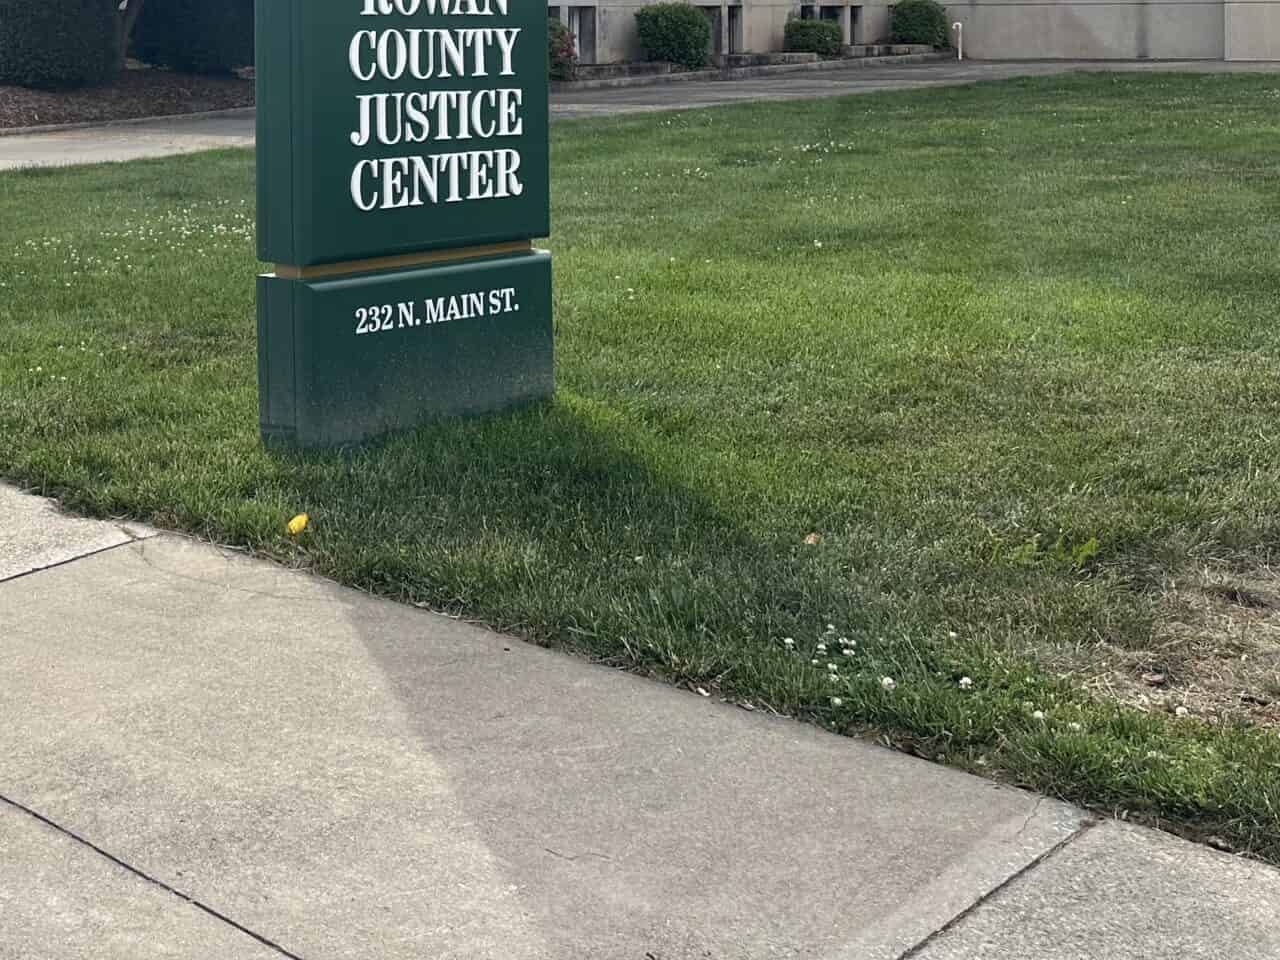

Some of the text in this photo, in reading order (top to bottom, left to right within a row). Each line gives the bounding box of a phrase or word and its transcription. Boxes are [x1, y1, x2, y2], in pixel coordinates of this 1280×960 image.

[348, 28, 522, 80] COUNTY
[350, 89, 523, 146] JUSTICE
[350, 148, 523, 211] CENTER
[355, 287, 520, 334] 232 N. MAIN ST.
